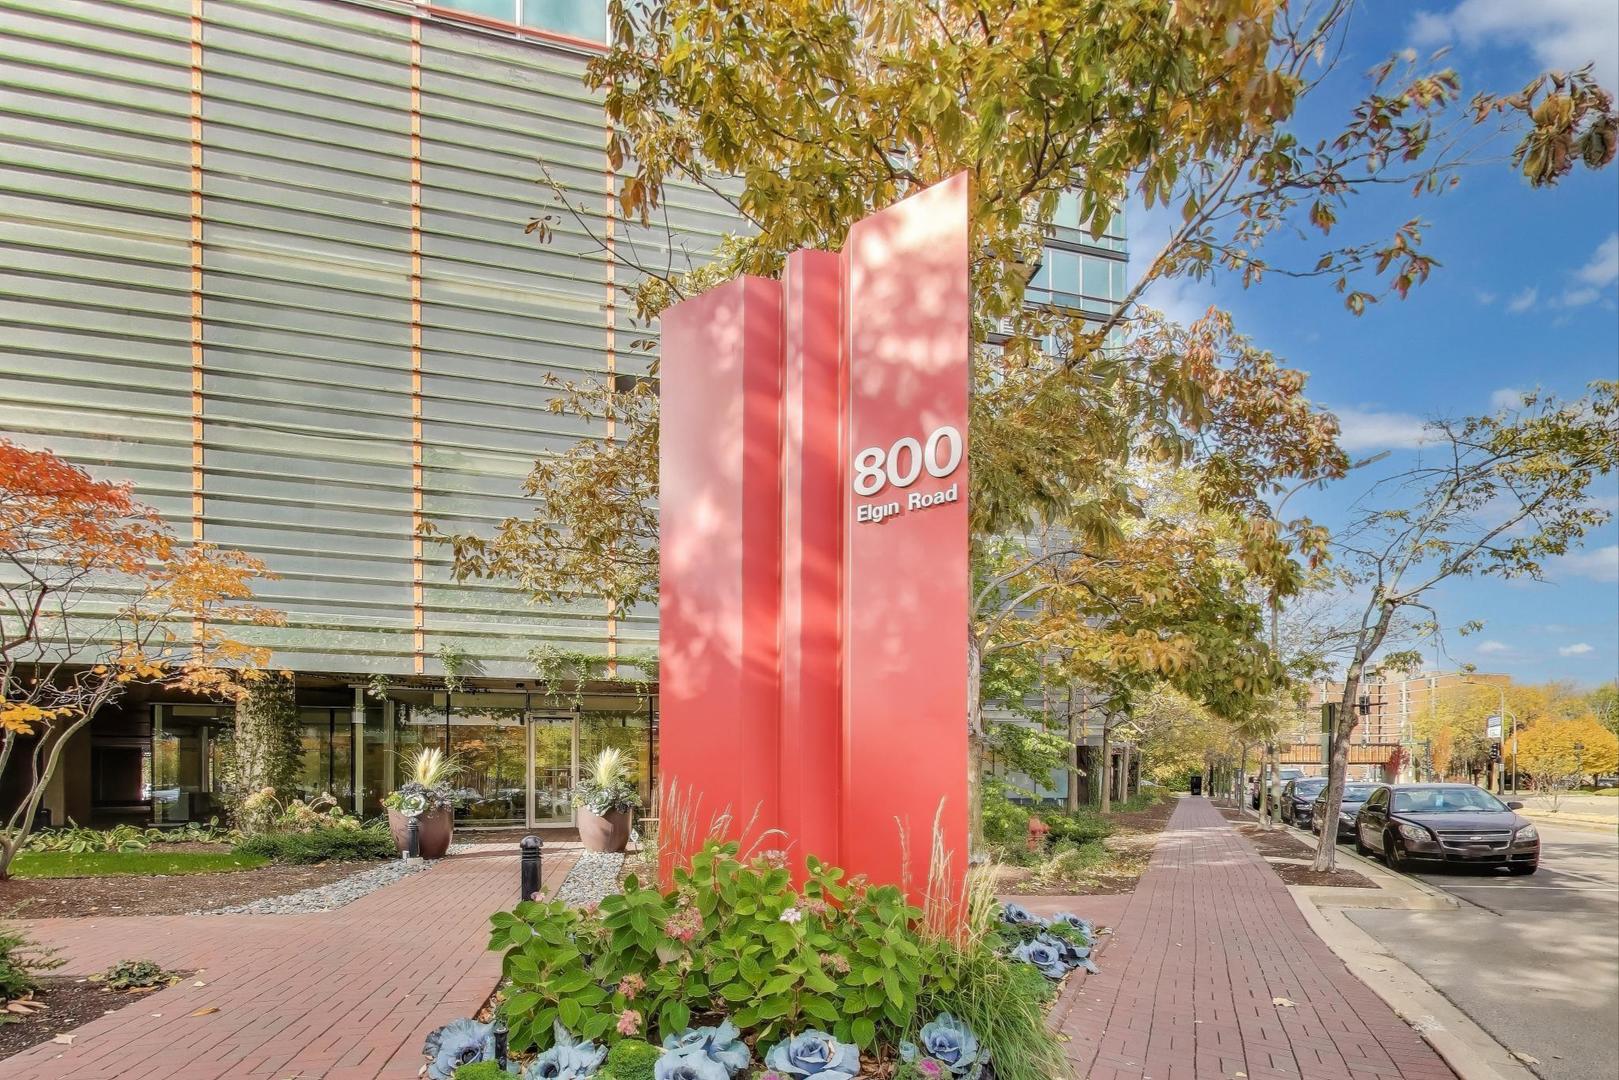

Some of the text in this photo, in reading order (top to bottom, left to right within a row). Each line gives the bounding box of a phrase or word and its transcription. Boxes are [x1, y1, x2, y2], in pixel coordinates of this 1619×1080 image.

[853, 425, 963, 496] 800
[857, 483, 958, 523] Elgin Road
